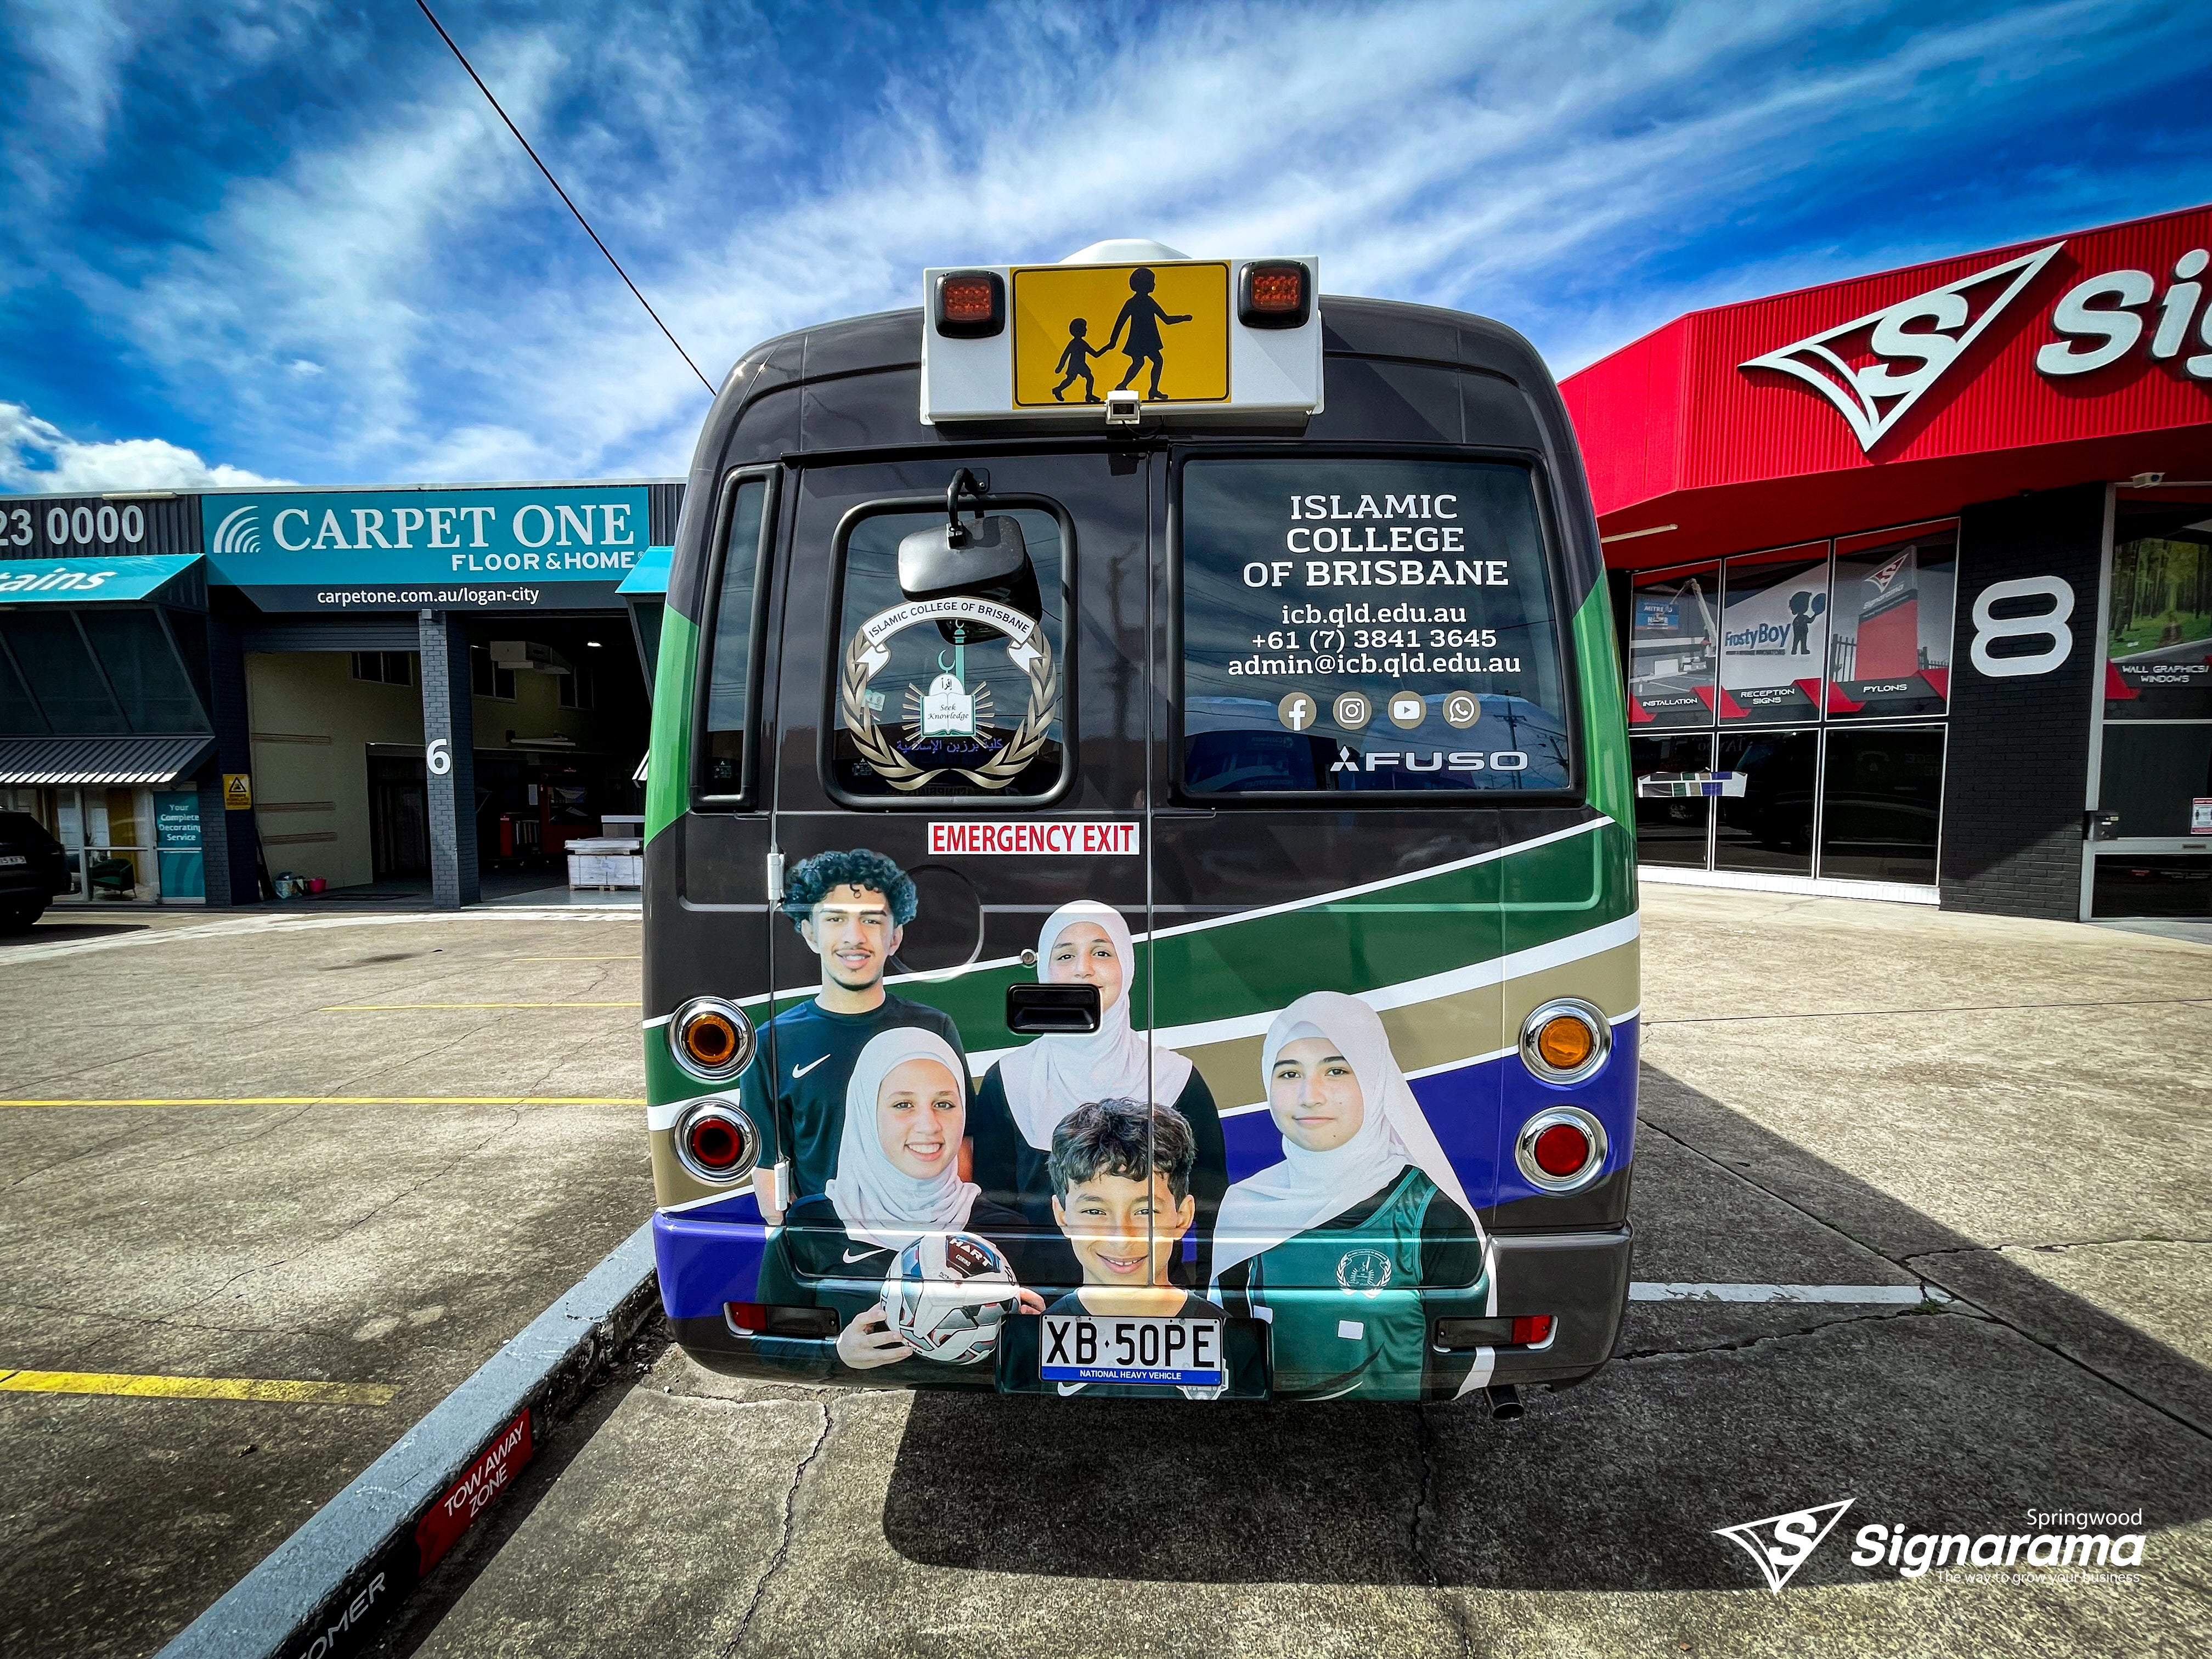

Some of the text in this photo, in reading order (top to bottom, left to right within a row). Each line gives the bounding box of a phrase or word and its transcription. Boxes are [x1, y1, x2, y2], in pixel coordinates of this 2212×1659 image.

[2035, 249, 2212, 380] Si
[1290, 494, 1458, 520] ISLAMIC
[47, 505, 144, 545] 0000
[273, 504, 634, 551] CARPET ONE
[1286, 527, 1464, 553] COLLEGE
[452, 553, 540, 571] FLOOR
[1243, 560, 1509, 588] OF BRISBANE
[317, 586, 539, 606] carpetone.com.au/logan-city
[869, 602, 1030, 637] ISLAMIC COLLEGE OF BRISBANE
[1282, 603, 1466, 628] icb.qld.edu.au
[1970, 575, 2075, 678] 8
[1252, 629, 1497, 653] +61 (7) 3841 3645
[1228, 653, 1521, 678] admin@icb.qld.edu.au
[1740, 689, 1795, 698] RECEPTION
[1752, 696, 1782, 704] SIGNS
[1863, 684, 1908, 693] PYLONS
[1643, 697, 1698, 707] INSTALLATION
[927, 712, 969, 721] Knowledge
[426, 738, 452, 775] 6
[1365, 751, 1528, 771] FUSO
[160, 814, 199, 822] Complete
[934, 825, 1134, 851] EMERGENCY EXIT
[1080, 1369, 1182, 1380] NATIONAL HEAVY VEHICLE
[444, 1421, 524, 1516] TOW AWAY
[469, 1463, 507, 1519] ZONE
[299, 1572, 385, 1659] OMER
